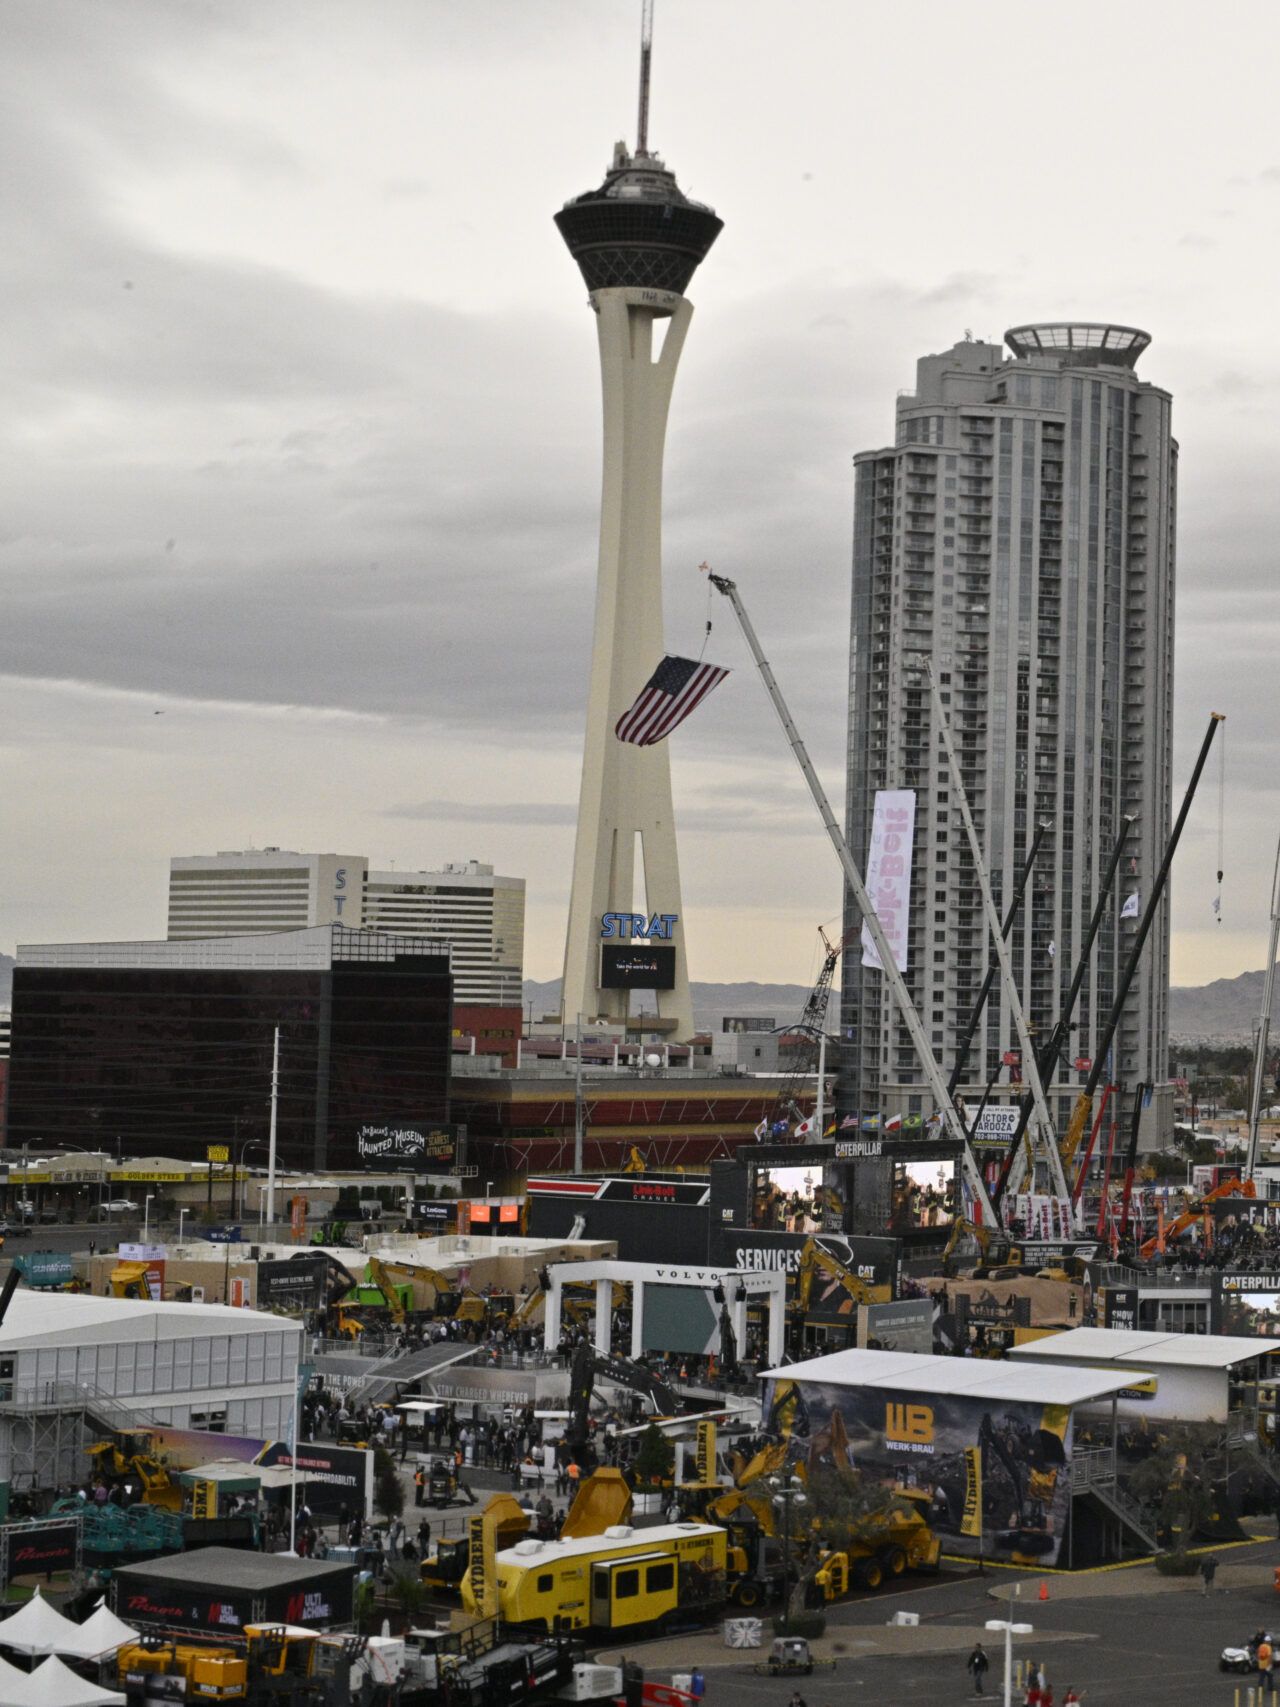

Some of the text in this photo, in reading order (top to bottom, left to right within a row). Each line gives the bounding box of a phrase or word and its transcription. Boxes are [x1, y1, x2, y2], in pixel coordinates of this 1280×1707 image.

[333, 868, 346, 927] ST
[601, 911, 679, 939] STRAT
[981, 1113, 1008, 1123] ICTOR
[977, 1122, 1013, 1132] ARDOZA
[357, 1132, 392, 1158] HAUNTED
[394, 1129, 425, 1149] MUSEUM
[835, 1142, 882, 1157] CATERPILLAR
[127, 1172, 156, 1180] GOLDEN
[722, 1208, 734, 1219] CAT
[736, 1248, 803, 1272] SERVICES
[656, 1269, 718, 1281] VOLVO
[858, 1264, 874, 1278] CAT
[1112, 1310, 1134, 1319] SHOW
[886, 1440, 935, 1454] WERK-BRAU
[964, 1448, 977, 1517] HYDREMA
[471, 1517, 484, 1600] HYDREMA
[192, 1607, 199, 1619] &
